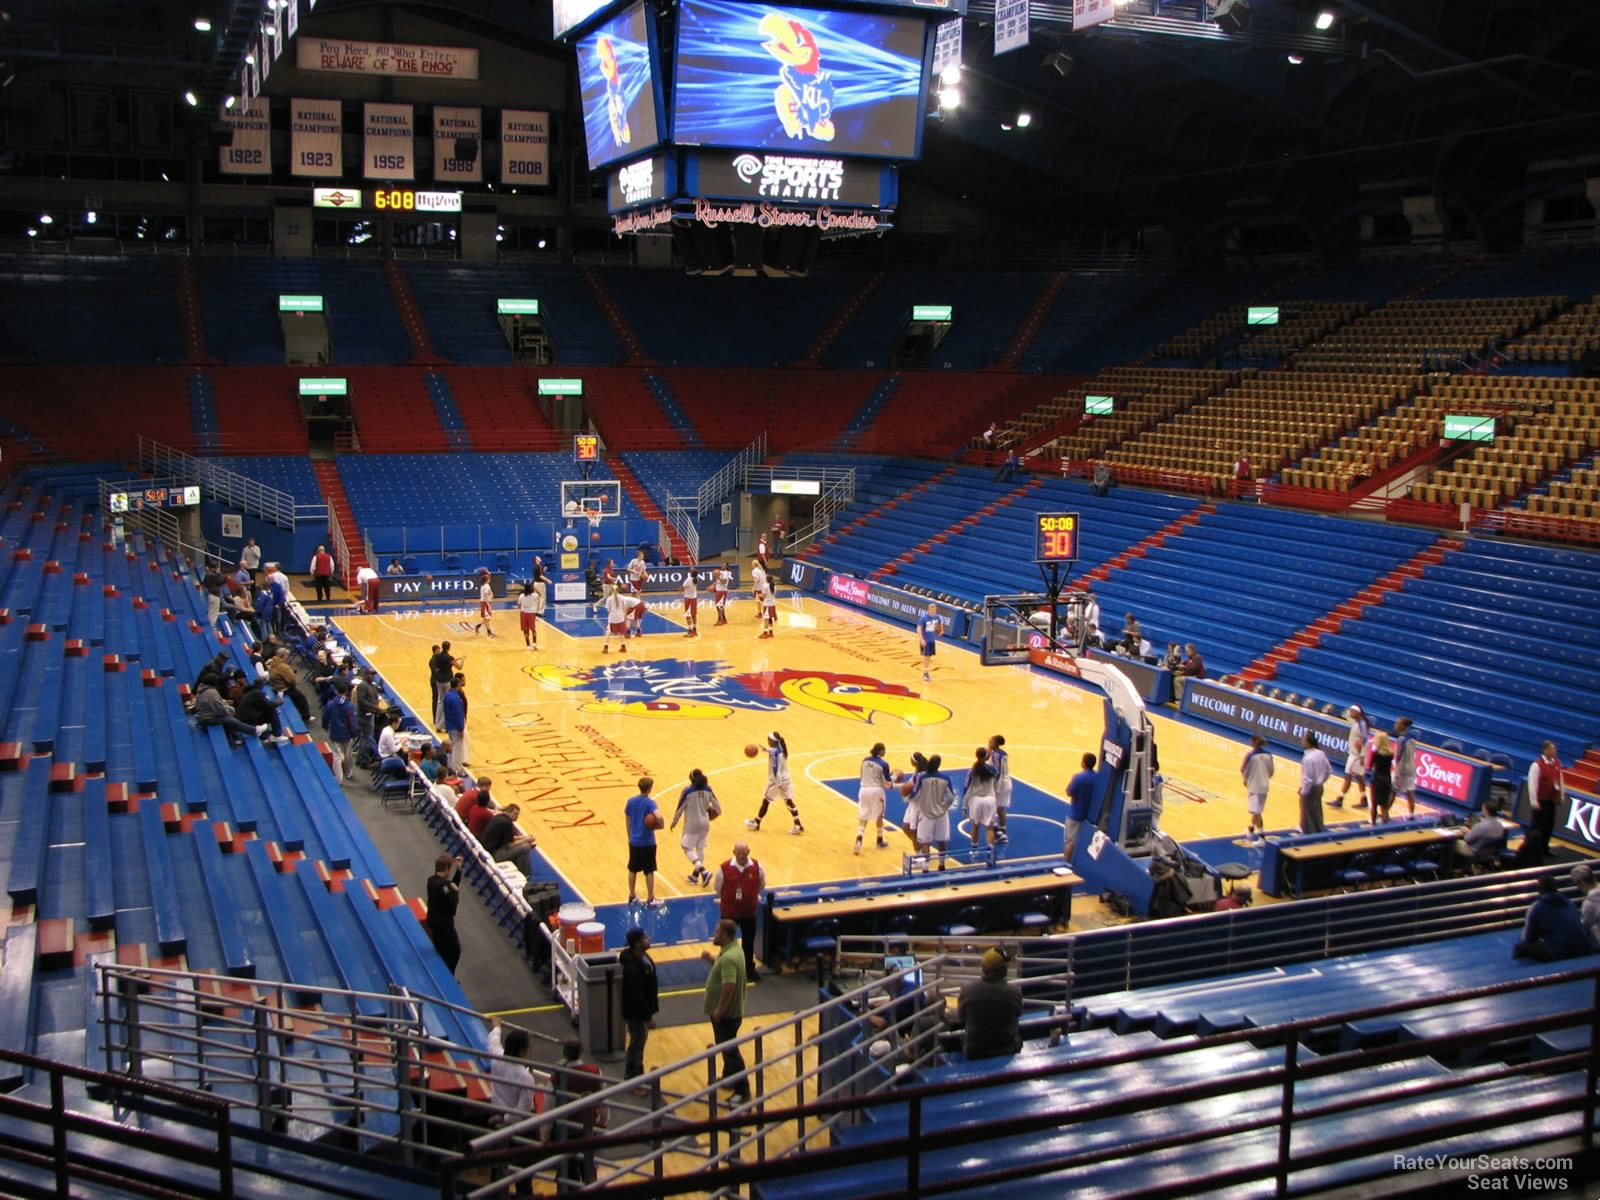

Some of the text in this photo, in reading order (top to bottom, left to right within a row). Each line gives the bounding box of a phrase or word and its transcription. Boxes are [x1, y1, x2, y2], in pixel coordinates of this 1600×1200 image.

[321, 55, 366, 70] BEWARE
[373, 58, 388, 71] OF
[802, 83, 821, 109] KU
[298, 111, 336, 122] NATIONAL
[370, 115, 408, 125] NATIONAL
[439, 118, 477, 128] NATIONAL
[293, 123, 340, 134] CHAMPIONS
[366, 128, 412, 137] CHAMPIONS
[508, 122, 544, 132] NATIONAL
[503, 135, 548, 144] CHAMPIONS
[228, 149, 262, 164] 1922
[301, 152, 333, 167] 1923
[373, 155, 405, 170] 1952
[442, 158, 474, 172] 1988
[509, 160, 542, 175] 2008
[760, 164, 844, 189] SPORTS
[376, 190, 413, 209] 6:08
[759, 184, 840, 200] CHANNEL
[693, 198, 877, 231] Russell Stover Candies
[579, 445, 594, 458] 30
[1040, 517, 1074, 531] 50:08
[1044, 532, 1070, 556] 30
[616, 574, 632, 584] AL
[646, 572, 682, 583] WHO
[791, 563, 805, 584] KU
[394, 582, 421, 593] PAY
[867, 592, 890, 607] WELCOME
[892, 600, 900, 610] TO
[901, 603, 916, 615] ALLEN
[1191, 692, 1236, 718] WELCOME
[1240, 708, 1254, 722] TO
[1257, 712, 1289, 734] ALLEN
[496, 711, 641, 791] JAYHAWKS
[1416, 754, 1464, 788] Stover
[485, 756, 607, 830] KANSAS
